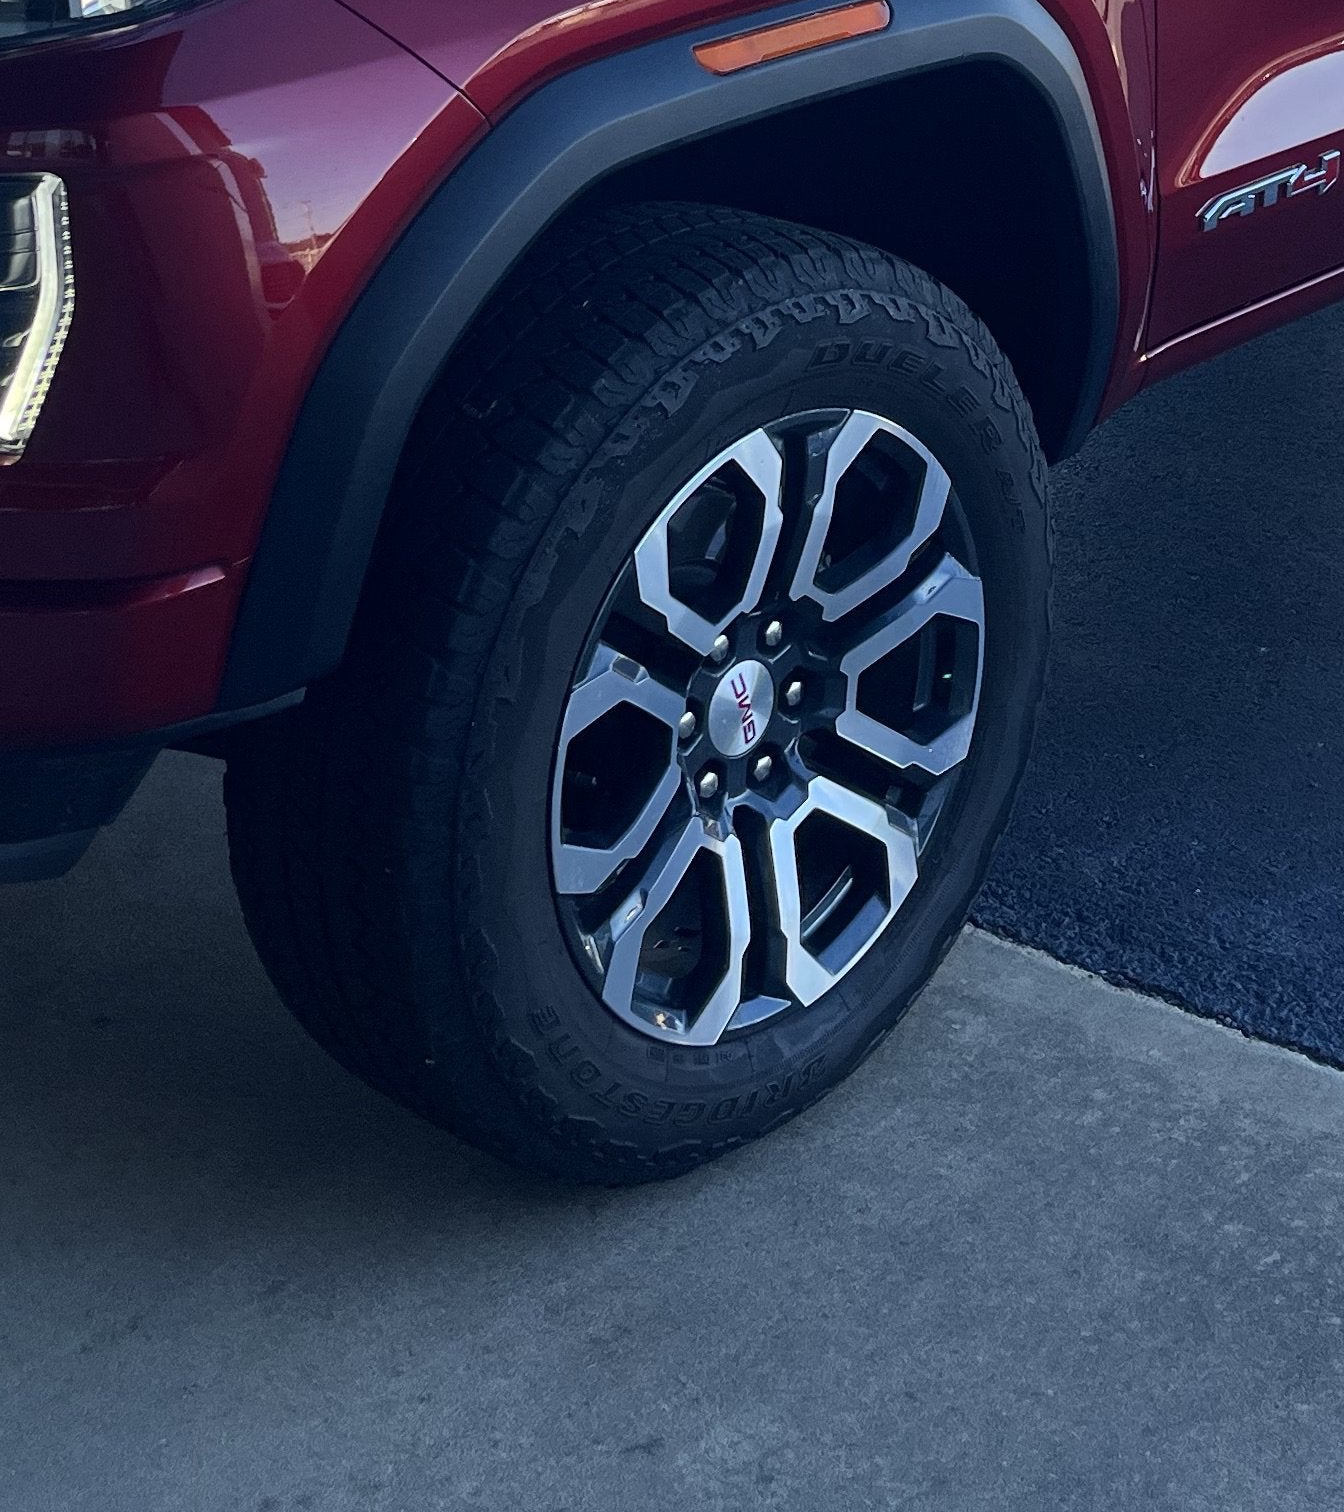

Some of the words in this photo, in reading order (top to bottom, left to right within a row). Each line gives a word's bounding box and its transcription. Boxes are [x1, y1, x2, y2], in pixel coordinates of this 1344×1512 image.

[1195, 149, 1341, 232] AT4
[730, 672, 756, 744] GMC
[531, 1004, 828, 1128] BRIDGESTONE
